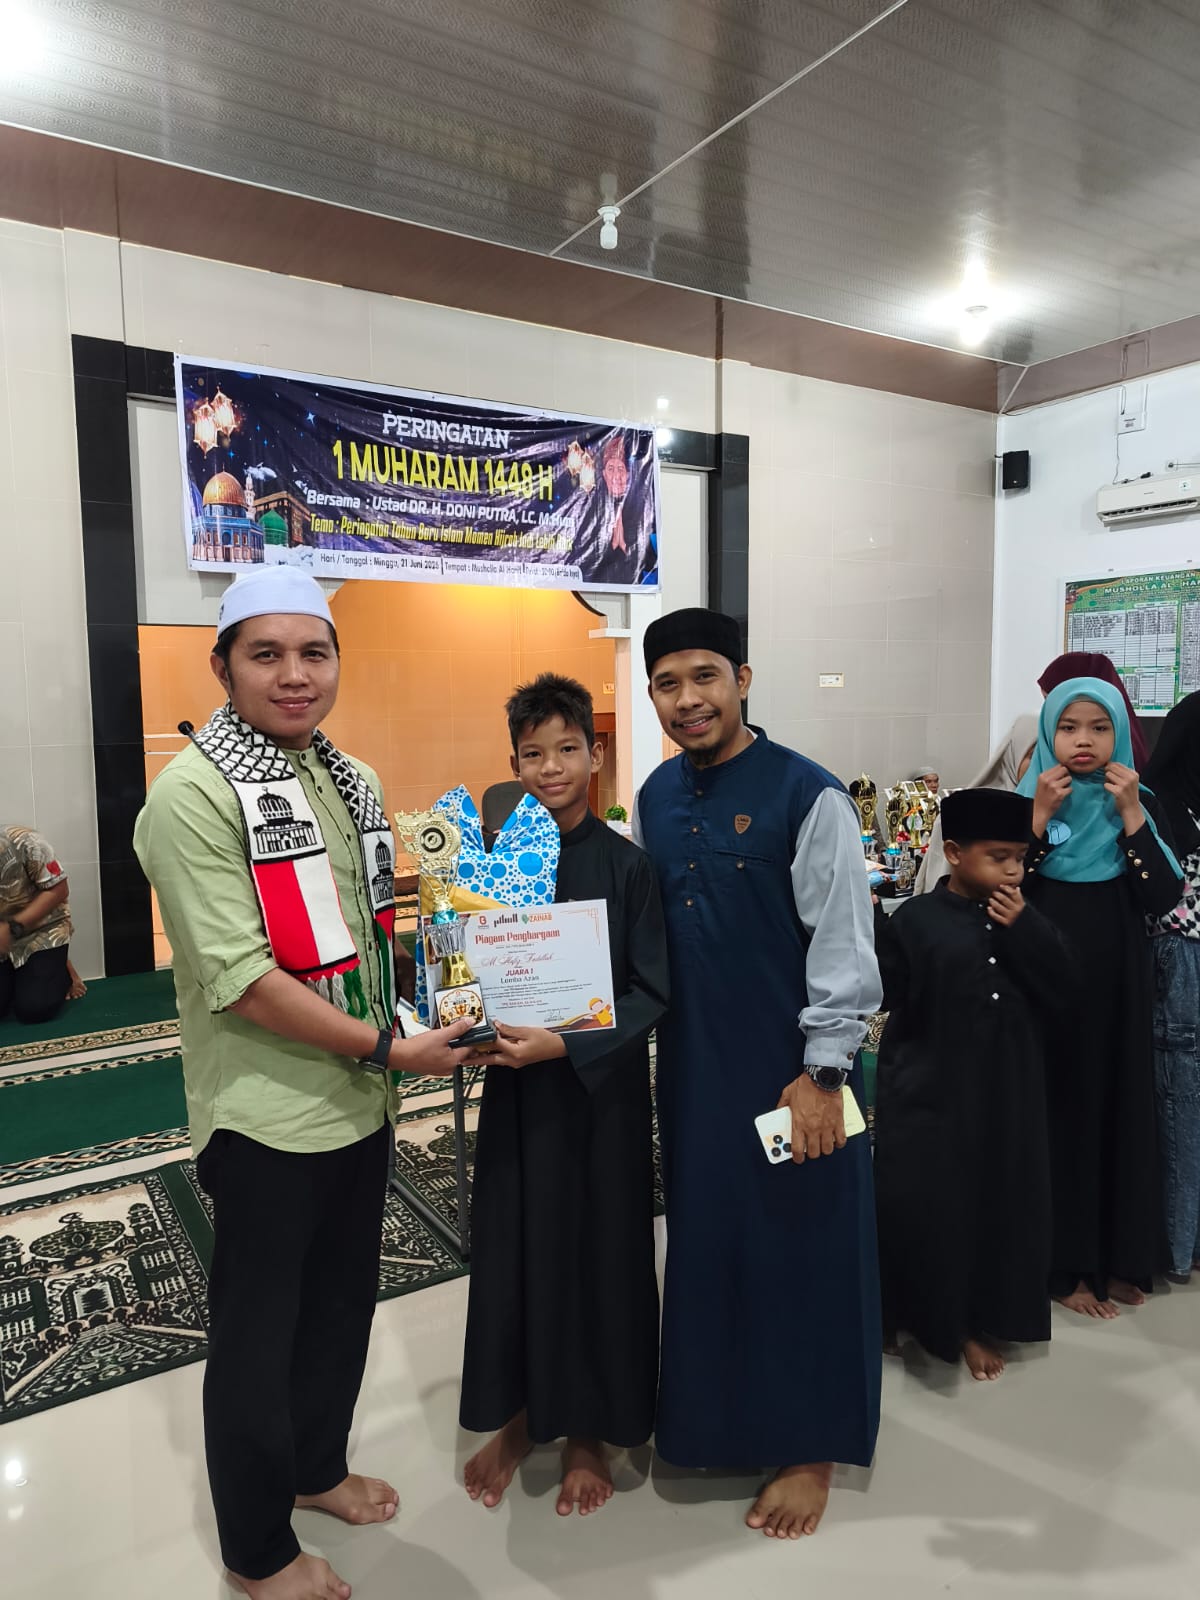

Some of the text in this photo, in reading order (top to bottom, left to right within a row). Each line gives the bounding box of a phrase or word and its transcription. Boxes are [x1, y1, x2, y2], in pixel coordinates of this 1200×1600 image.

[382, 413, 511, 448] PERINGATAN
[332, 440, 553, 501] 1 MUHARAM 1448 H
[306, 490, 361, 509] Bersama
[372, 496, 407, 513] Ustad
[409, 500, 430, 514] DR.
[432, 501, 444, 516] H.
[446, 503, 476, 519] DONI
[478, 506, 519, 525] PUTRA,
[521, 510, 536, 525] LC.
[310, 513, 334, 533] Tema
[340, 516, 389, 540] Peringatan
[391, 521, 417, 540] Tahun
[418, 523, 439, 542] Baru
[440, 525, 464, 543] Islam
[464, 526, 493, 546] Momen
[494, 529, 517, 549] Hijrah
[320, 553, 335, 563] Hari
[341, 555, 368, 568] Tanggal
[373, 557, 400, 569] Minggu,
[400, 558, 408, 568] 21
[410, 559, 423, 569] Juni
[445, 562, 467, 573] Tempat
[1121, 572, 1196, 585] LAPORAN KEUANGAN
[1104, 584, 1157, 594] MUSHOLLA
[475, 930, 560, 945] Piagam Penghargaan
[505, 969, 529, 977] JUARA
